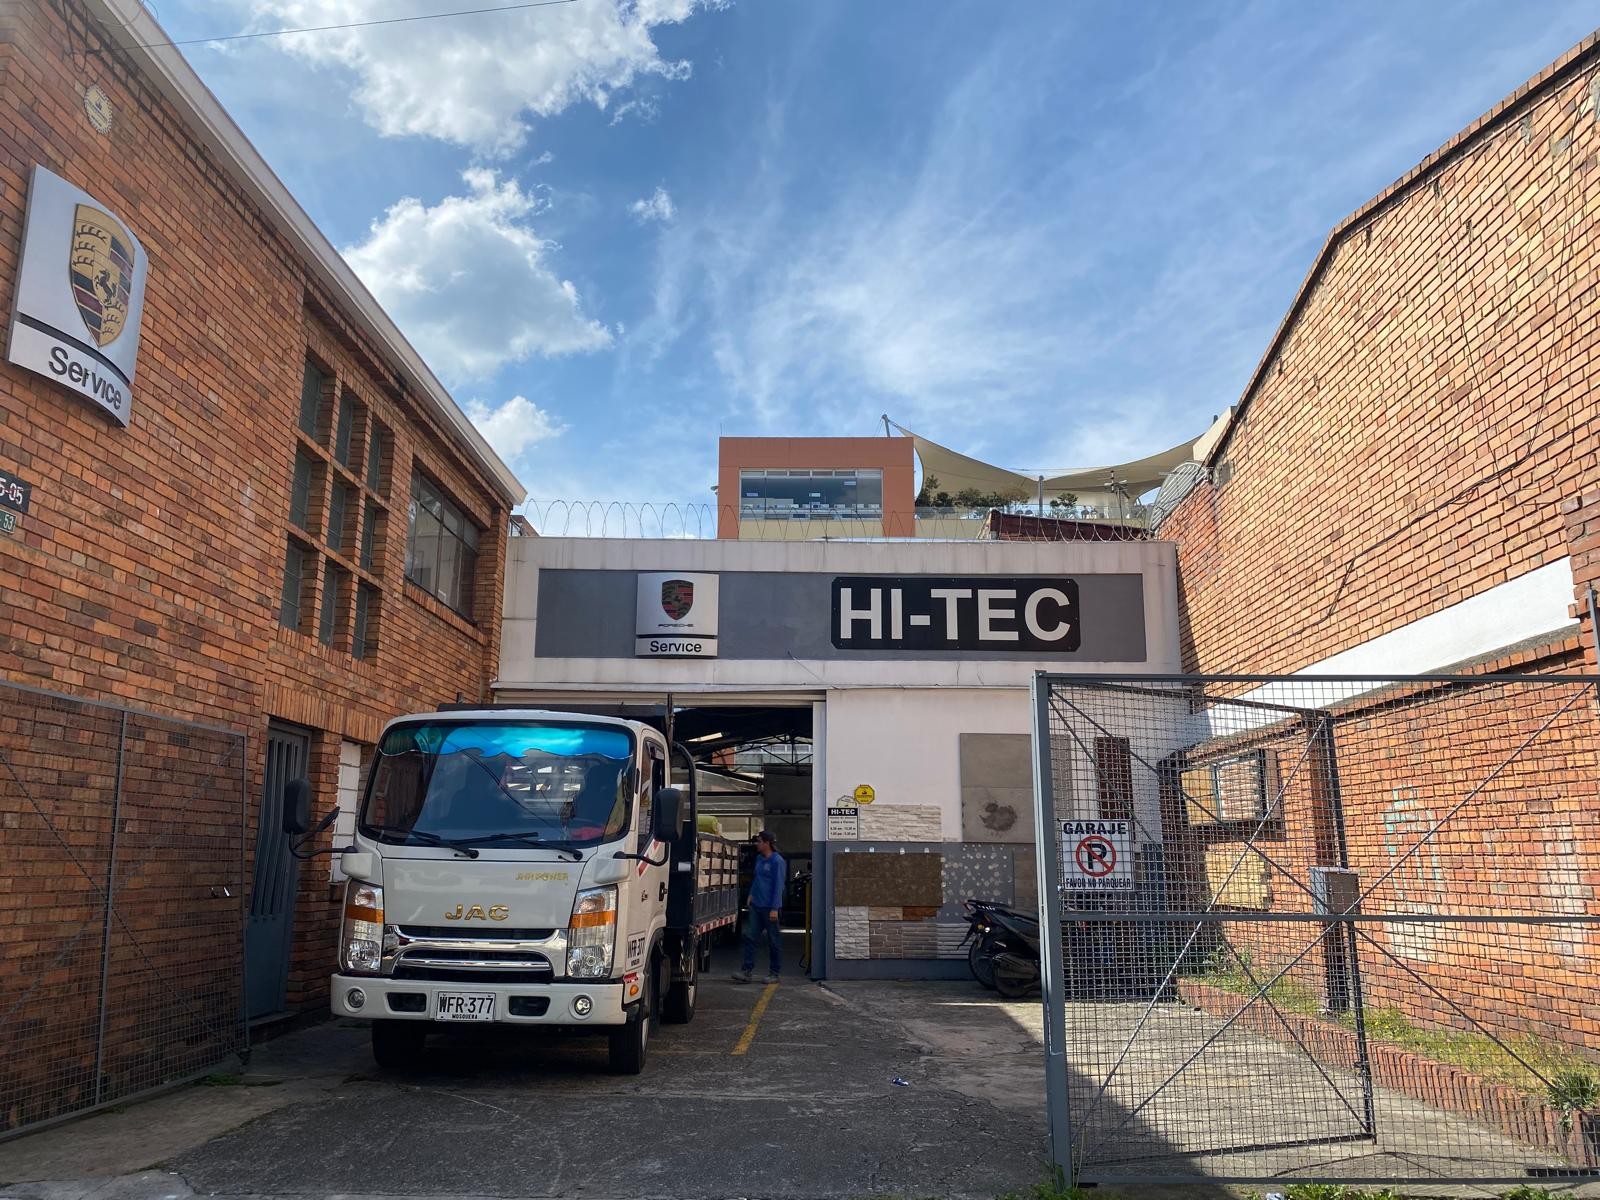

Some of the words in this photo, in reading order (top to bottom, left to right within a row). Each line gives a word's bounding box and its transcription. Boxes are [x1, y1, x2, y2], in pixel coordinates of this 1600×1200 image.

[48, 346, 122, 410] Service
[840, 587, 1071, 641] HI-TEC
[650, 640, 702, 653] Service
[1063, 822, 1127, 835] GARAJE
[1065, 878, 1086, 888] FAVOR
[1087, 878, 1097, 888] NO
[1099, 878, 1131, 888] PARQUEAR
[445, 904, 509, 921] JAC
